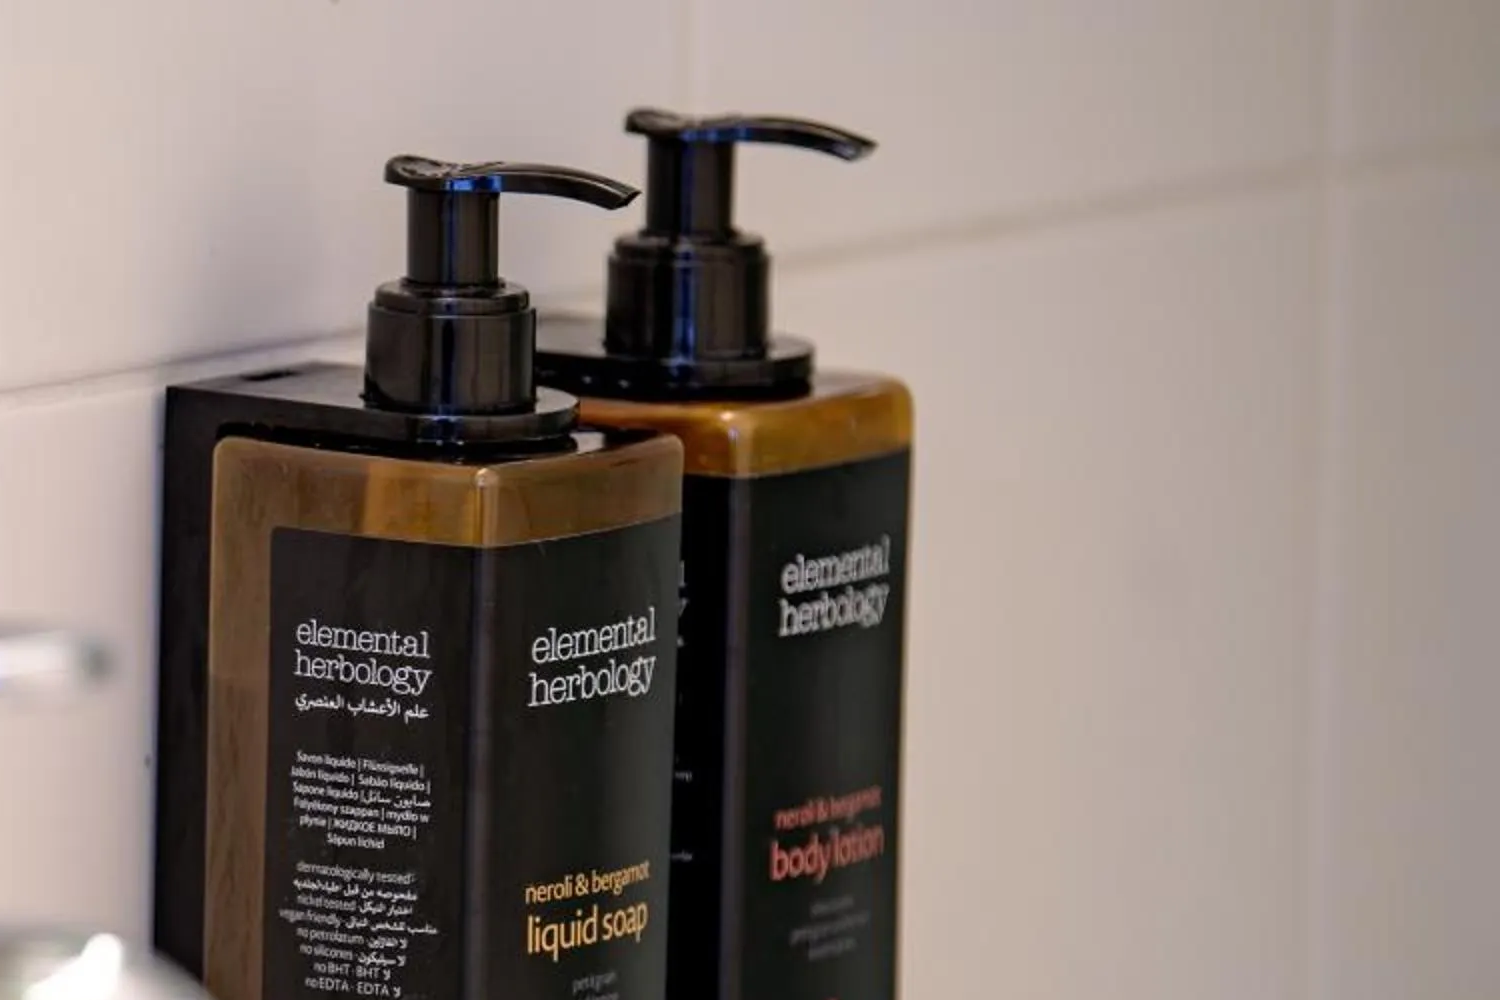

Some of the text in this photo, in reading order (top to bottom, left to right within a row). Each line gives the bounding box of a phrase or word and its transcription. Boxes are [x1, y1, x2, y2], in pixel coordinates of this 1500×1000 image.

[780, 534, 890, 594] elemental
[778, 583, 890, 637] herbology
[296, 619, 431, 659] elemental
[531, 606, 656, 664] elemental
[294, 649, 433, 696] herbology
[527, 656, 656, 707] herbology
[295, 693, 429, 724] علم الأعشاب العنصري
[770, 823, 884, 884] body lotion
[525, 860, 651, 904] neroli & bergamot
[527, 902, 648, 962] liquid soap
[319, 976, 349, 992] EDTA
[327, 961, 350, 975] BHT
[356, 980, 389, 997] EDTA
